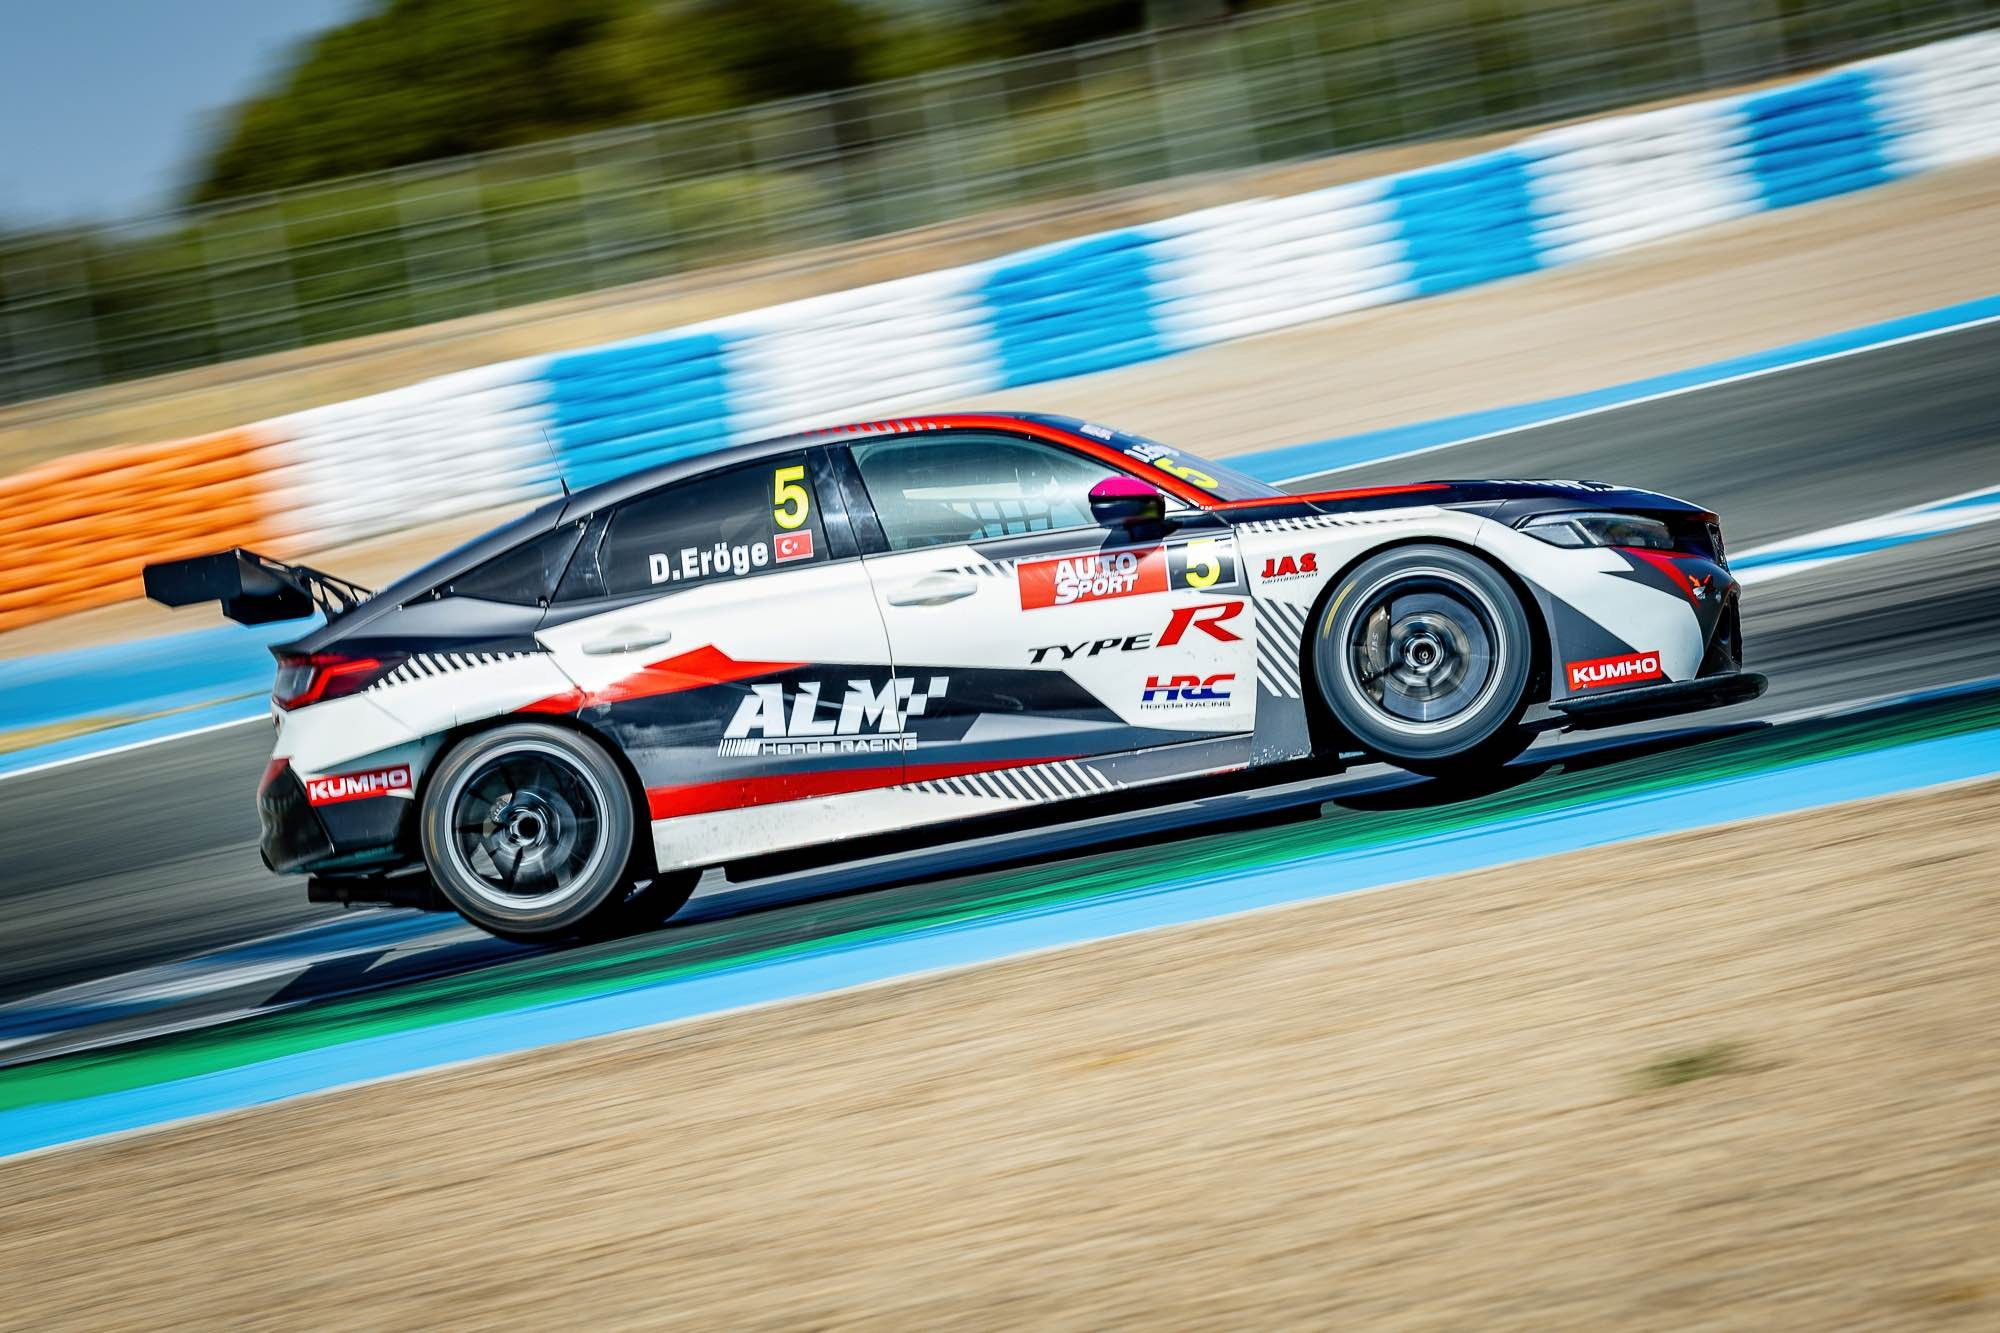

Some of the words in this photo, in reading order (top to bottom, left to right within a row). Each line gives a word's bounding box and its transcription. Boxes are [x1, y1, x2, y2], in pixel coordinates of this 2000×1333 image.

[1154, 457, 1218, 489] 5
[773, 465, 810, 529] 5
[649, 541, 769, 585] D.Eröge
[1055, 552, 1138, 584] AUTO
[1185, 538, 1221, 589] 5
[1055, 573, 1139, 605] SPORT
[1028, 632, 1153, 664] TYPE
[1156, 601, 1244, 647] R
[1572, 657, 1658, 684] KUMHO
[1141, 673, 1236, 702] HRC
[723, 678, 915, 739] ALM
[1140, 702, 1183, 710] Honda
[1185, 700, 1231, 708] RACING
[762, 741, 835, 756] Honda
[840, 738, 917, 753] RACING
[309, 768, 408, 801] KUMHO
